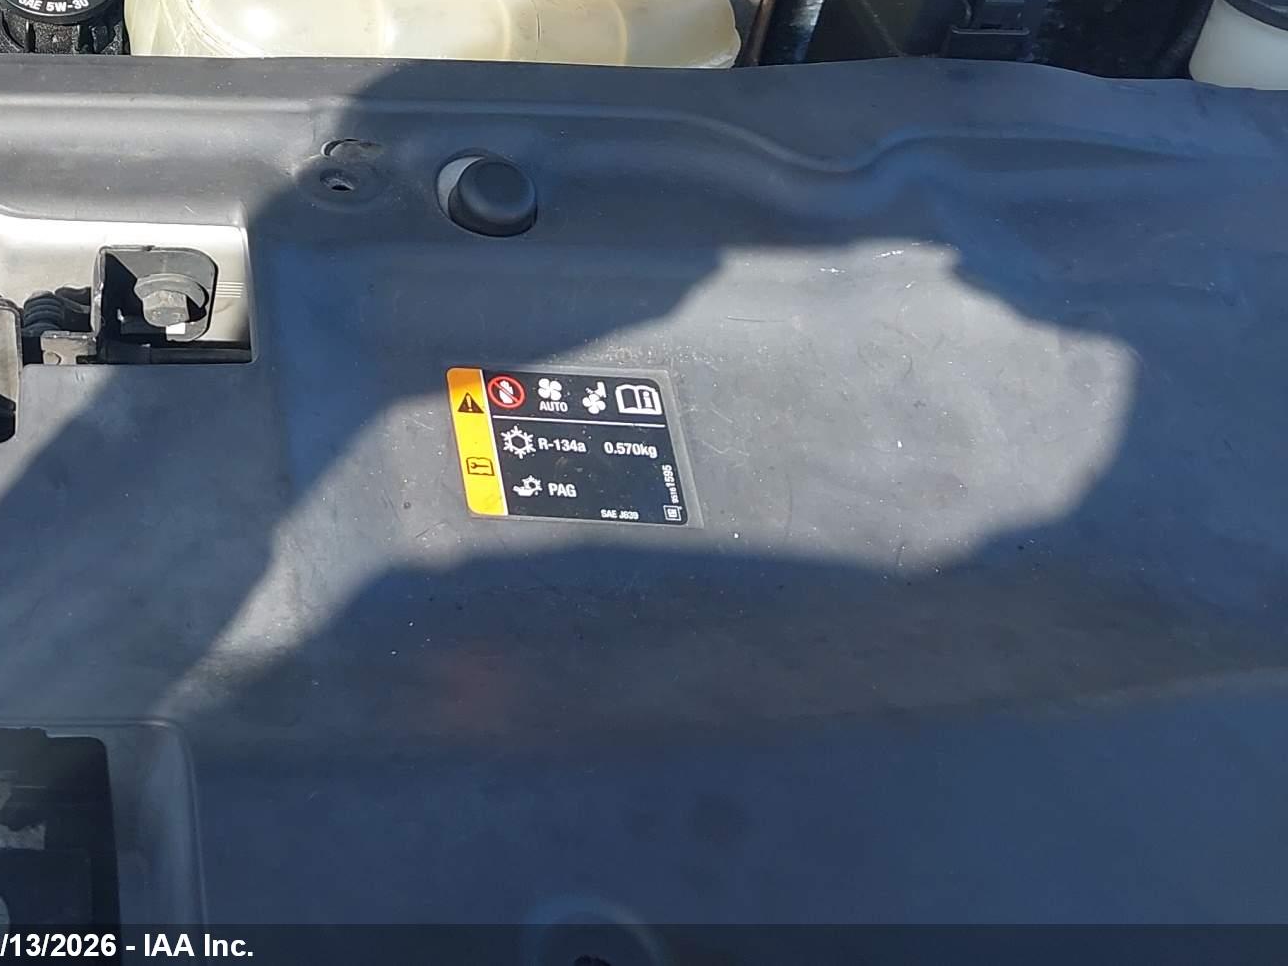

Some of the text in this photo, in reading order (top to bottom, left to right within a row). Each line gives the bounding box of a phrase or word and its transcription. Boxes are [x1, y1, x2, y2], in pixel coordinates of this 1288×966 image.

[538, 400, 569, 413] AUTO
[538, 437, 659, 459] R-134a 0.570kg
[548, 482, 577, 498] PAG
[600, 509, 639, 521] SAE J639
